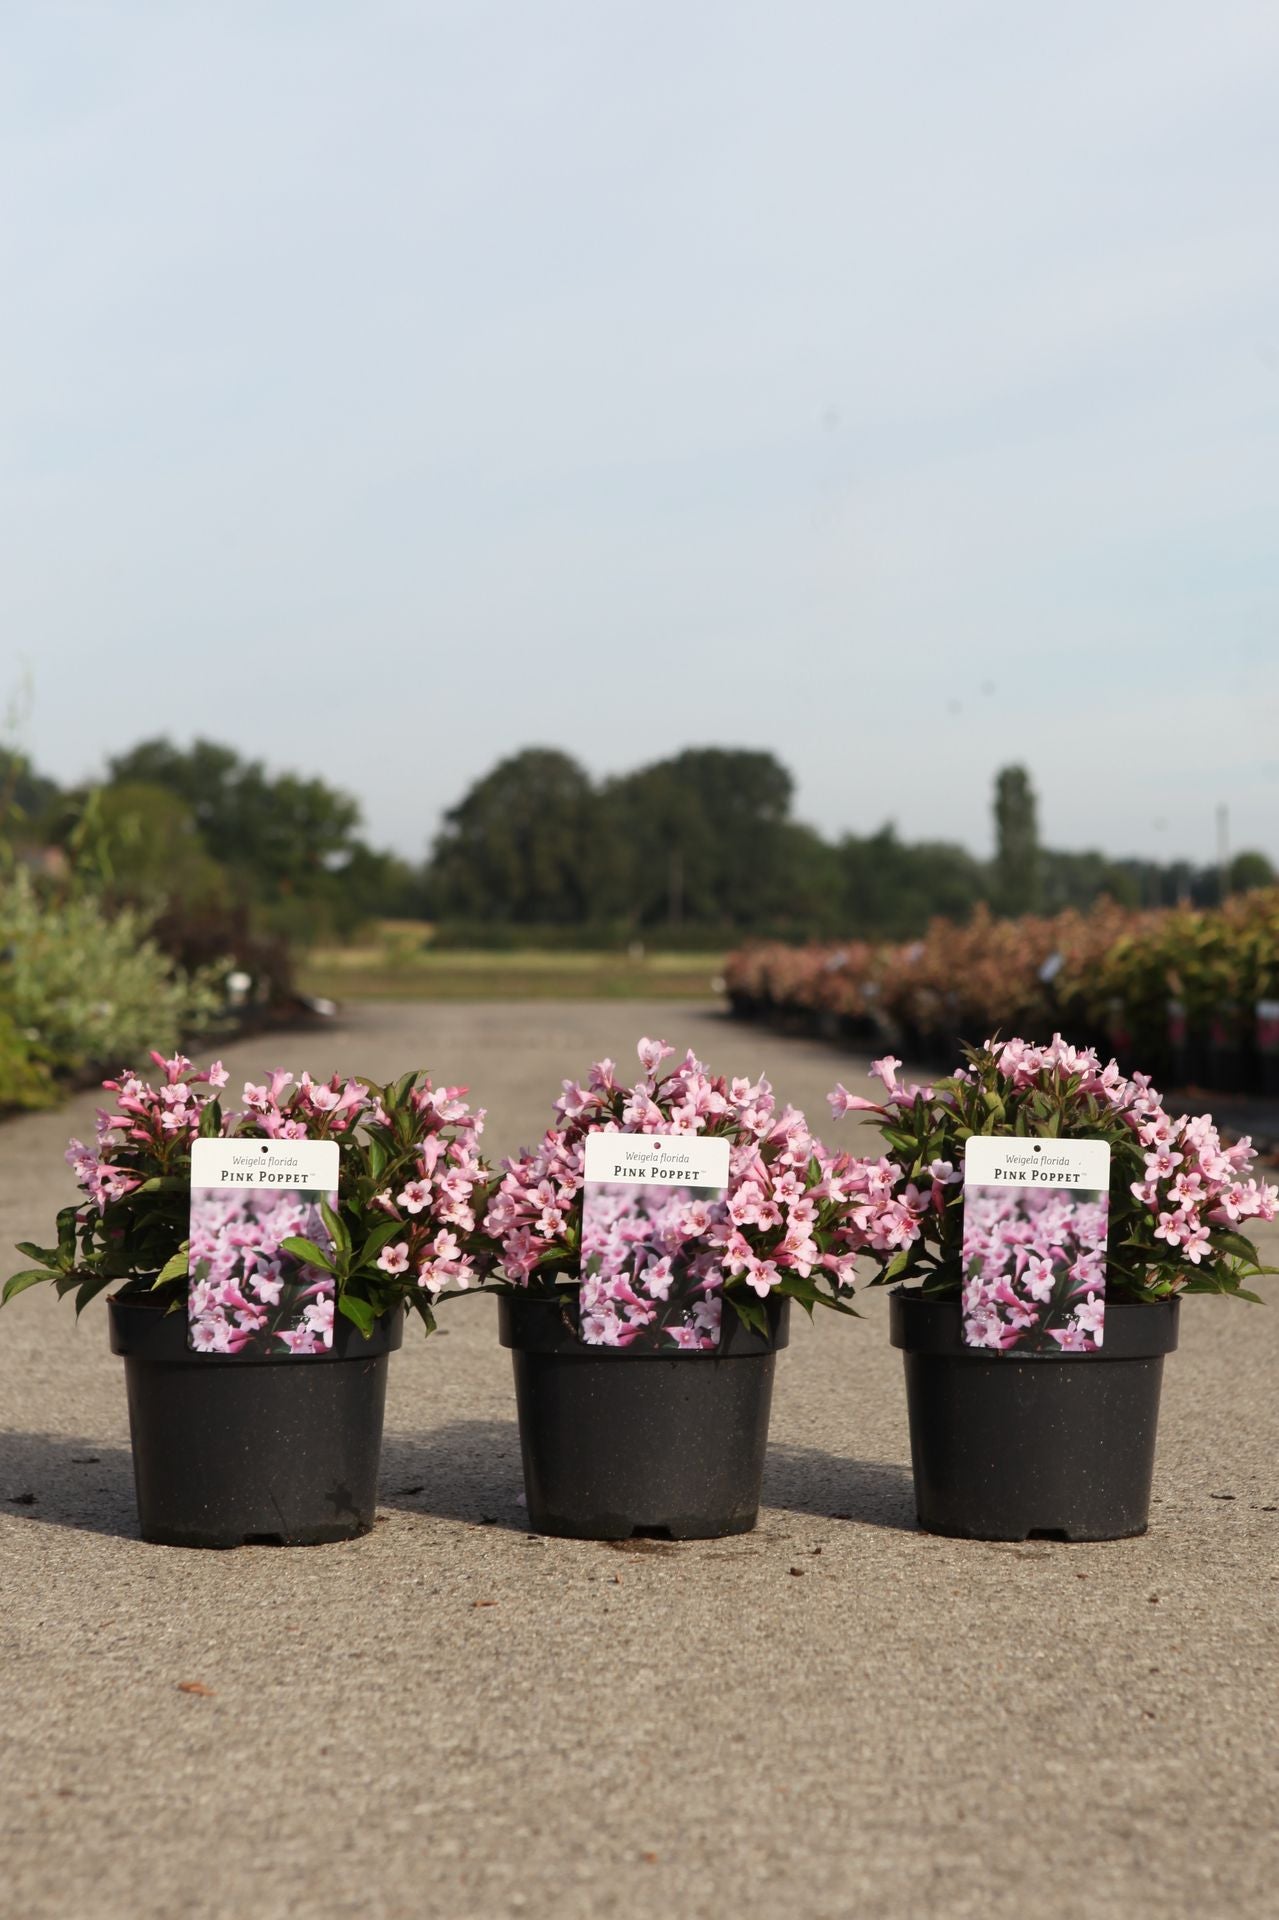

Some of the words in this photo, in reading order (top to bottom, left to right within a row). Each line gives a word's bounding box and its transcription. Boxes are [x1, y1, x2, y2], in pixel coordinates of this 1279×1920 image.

[232, 1156, 266, 1168] Weigela
[268, 1156, 298, 1168] florida
[625, 1152, 658, 1163] Weigela
[660, 1153, 690, 1164] florida
[1005, 1154, 1039, 1166] Weigela
[1040, 1155, 1070, 1167] florida
[221, 1170, 254, 1182] PINK
[614, 1165, 646, 1177] PINK
[994, 1168, 1027, 1180] PINK
